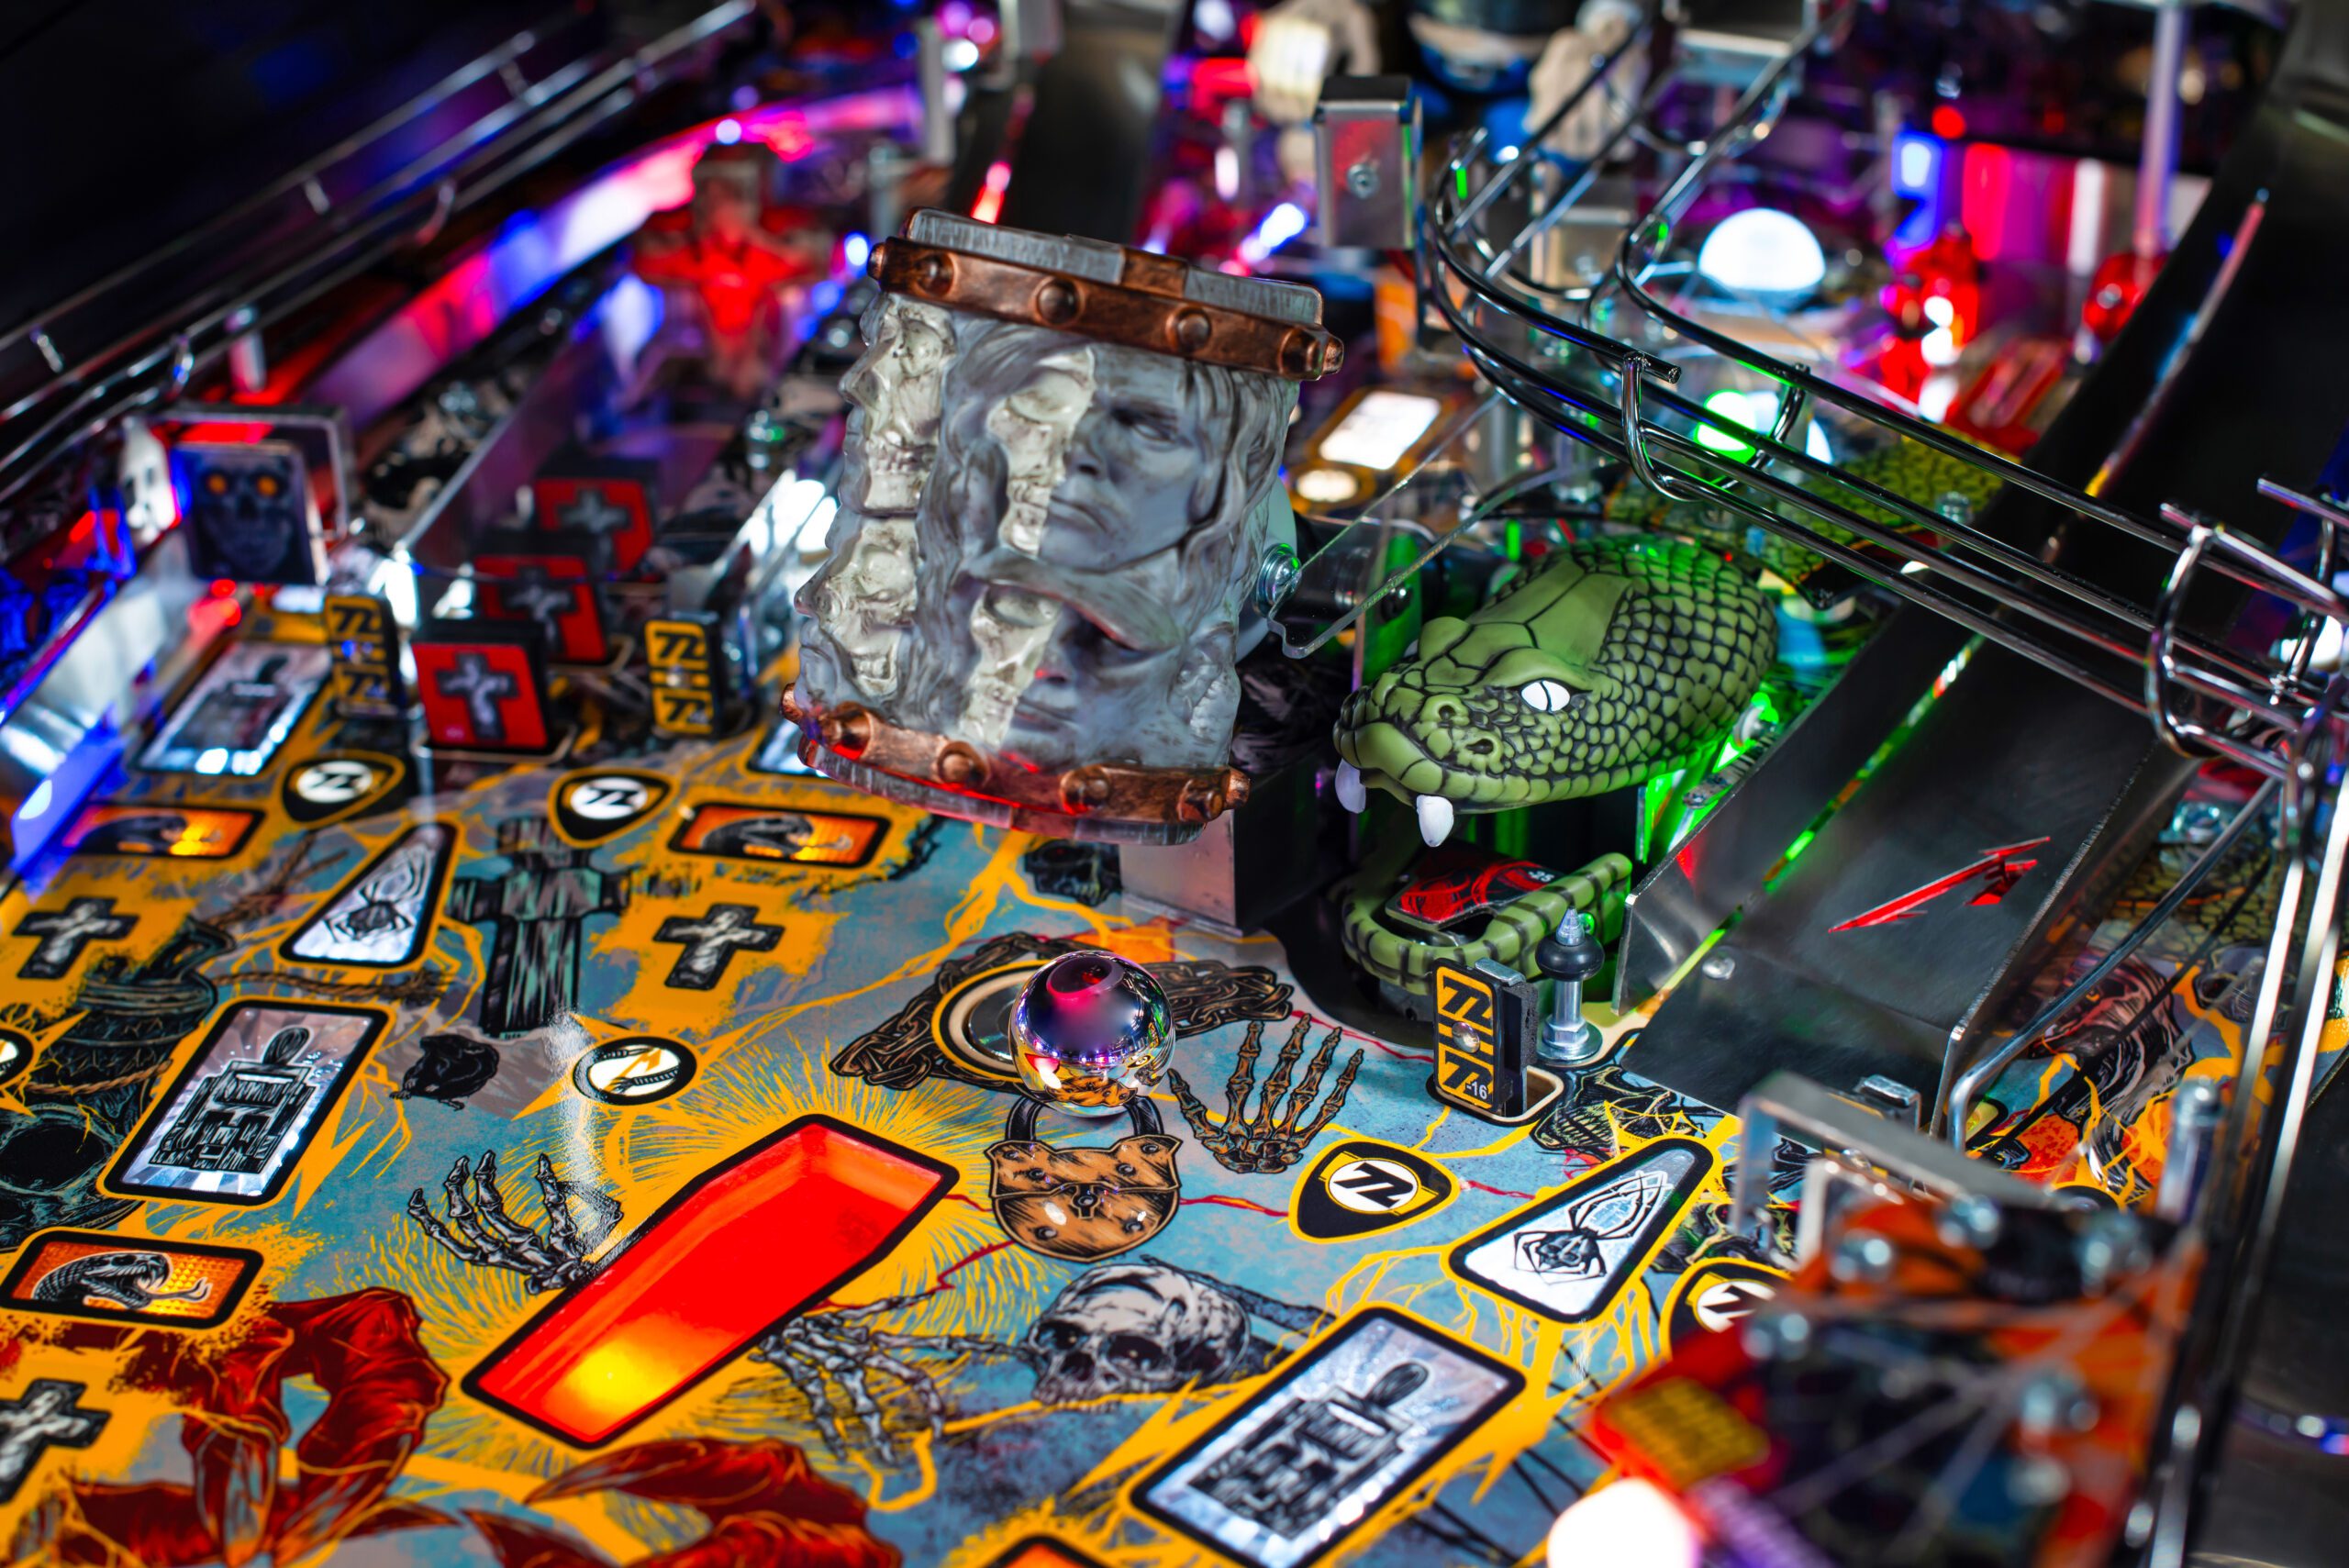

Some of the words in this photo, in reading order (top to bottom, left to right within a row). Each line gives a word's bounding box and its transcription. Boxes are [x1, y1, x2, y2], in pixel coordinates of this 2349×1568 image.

[1442, 975, 1494, 1029] 72
[1466, 1081, 1488, 1100] -16
[1333, 1162, 1414, 1208] 72
